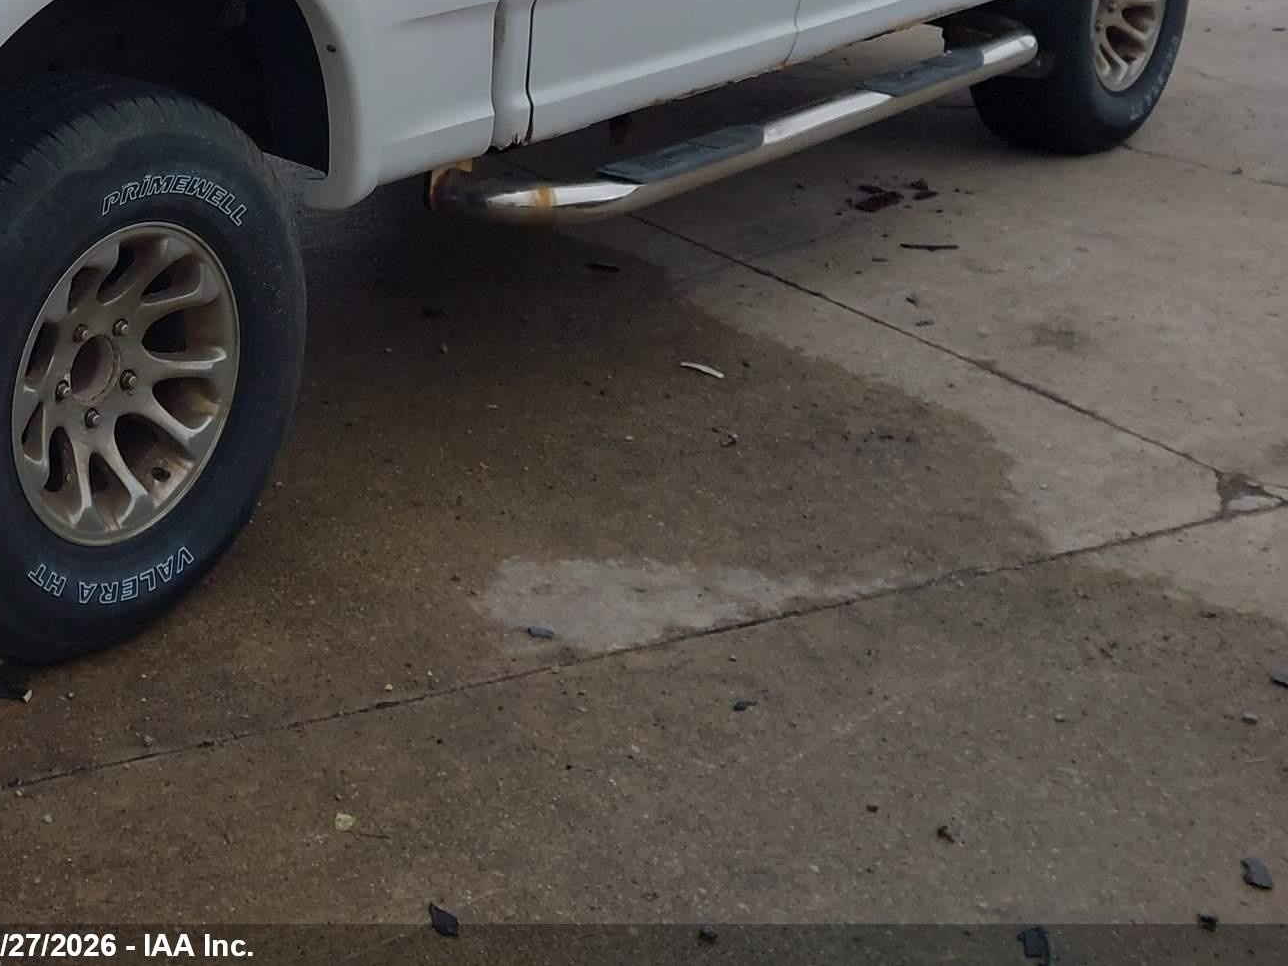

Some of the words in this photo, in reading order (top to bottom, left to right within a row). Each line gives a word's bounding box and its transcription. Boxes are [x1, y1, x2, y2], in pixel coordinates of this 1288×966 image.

[101, 174, 248, 227] PRIMEWELL
[28, 563, 68, 597] HT
[78, 546, 195, 604] VALERA
